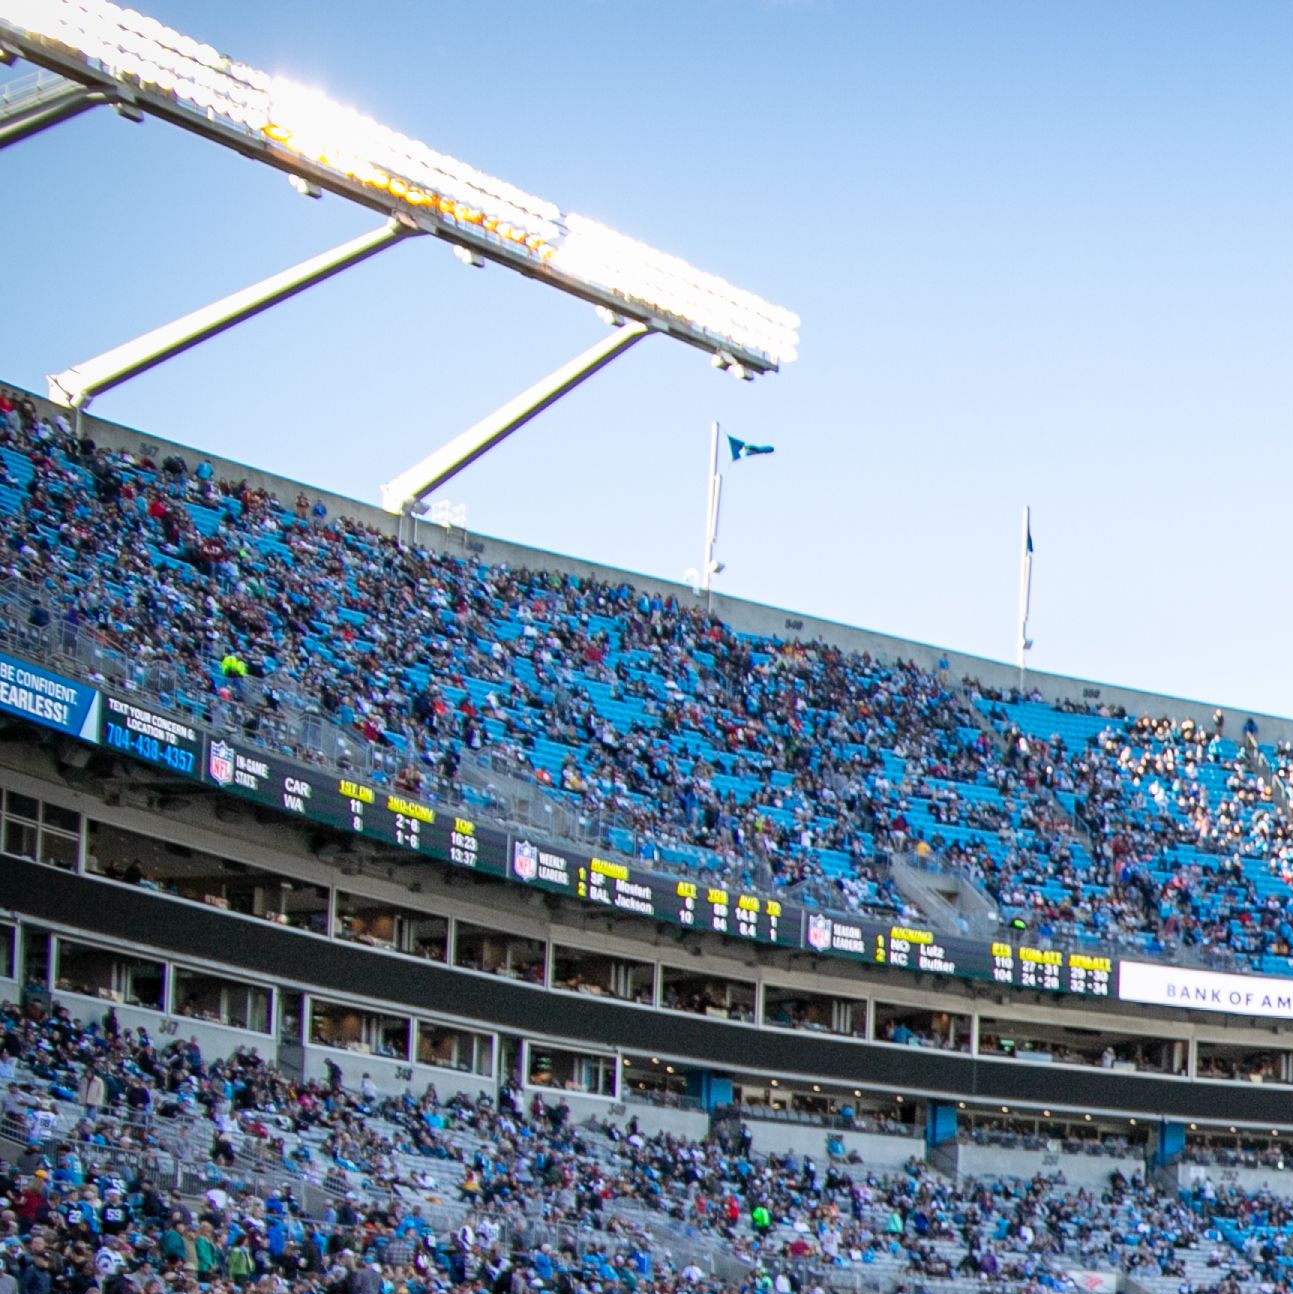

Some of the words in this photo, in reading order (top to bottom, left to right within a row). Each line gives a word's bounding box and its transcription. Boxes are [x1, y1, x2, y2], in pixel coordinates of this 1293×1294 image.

[0, 662, 15, 680] BE
[16, 669, 78, 705] CONFIDENT.
[0, 682, 68, 725] EARLESS!
[109, 698, 130, 714] TEXT
[130, 704, 153, 722] YOUR
[153, 712, 187, 737] CONCERN
[127, 717, 164, 741] LOCATION
[165, 732, 178, 745] TO
[107, 722, 195, 773] 704-438-4357
[213, 759, 228, 781] NFL
[236, 755, 269, 779] IN-GAME
[284, 777, 312, 799] CAR
[284, 793, 305, 813] WA
[350, 799, 363, 814] 11
[353, 816, 363, 831] 8
[450, 832, 478, 851] 16:23
[450, 847, 478, 867] 13:37
[890, 939, 910, 953] NO
[920, 944, 945, 959] Lutz
[890, 951, 909, 966] KC
[1166, 983, 1222, 1005] BANK
[1229, 990, 1253, 1007] OF
